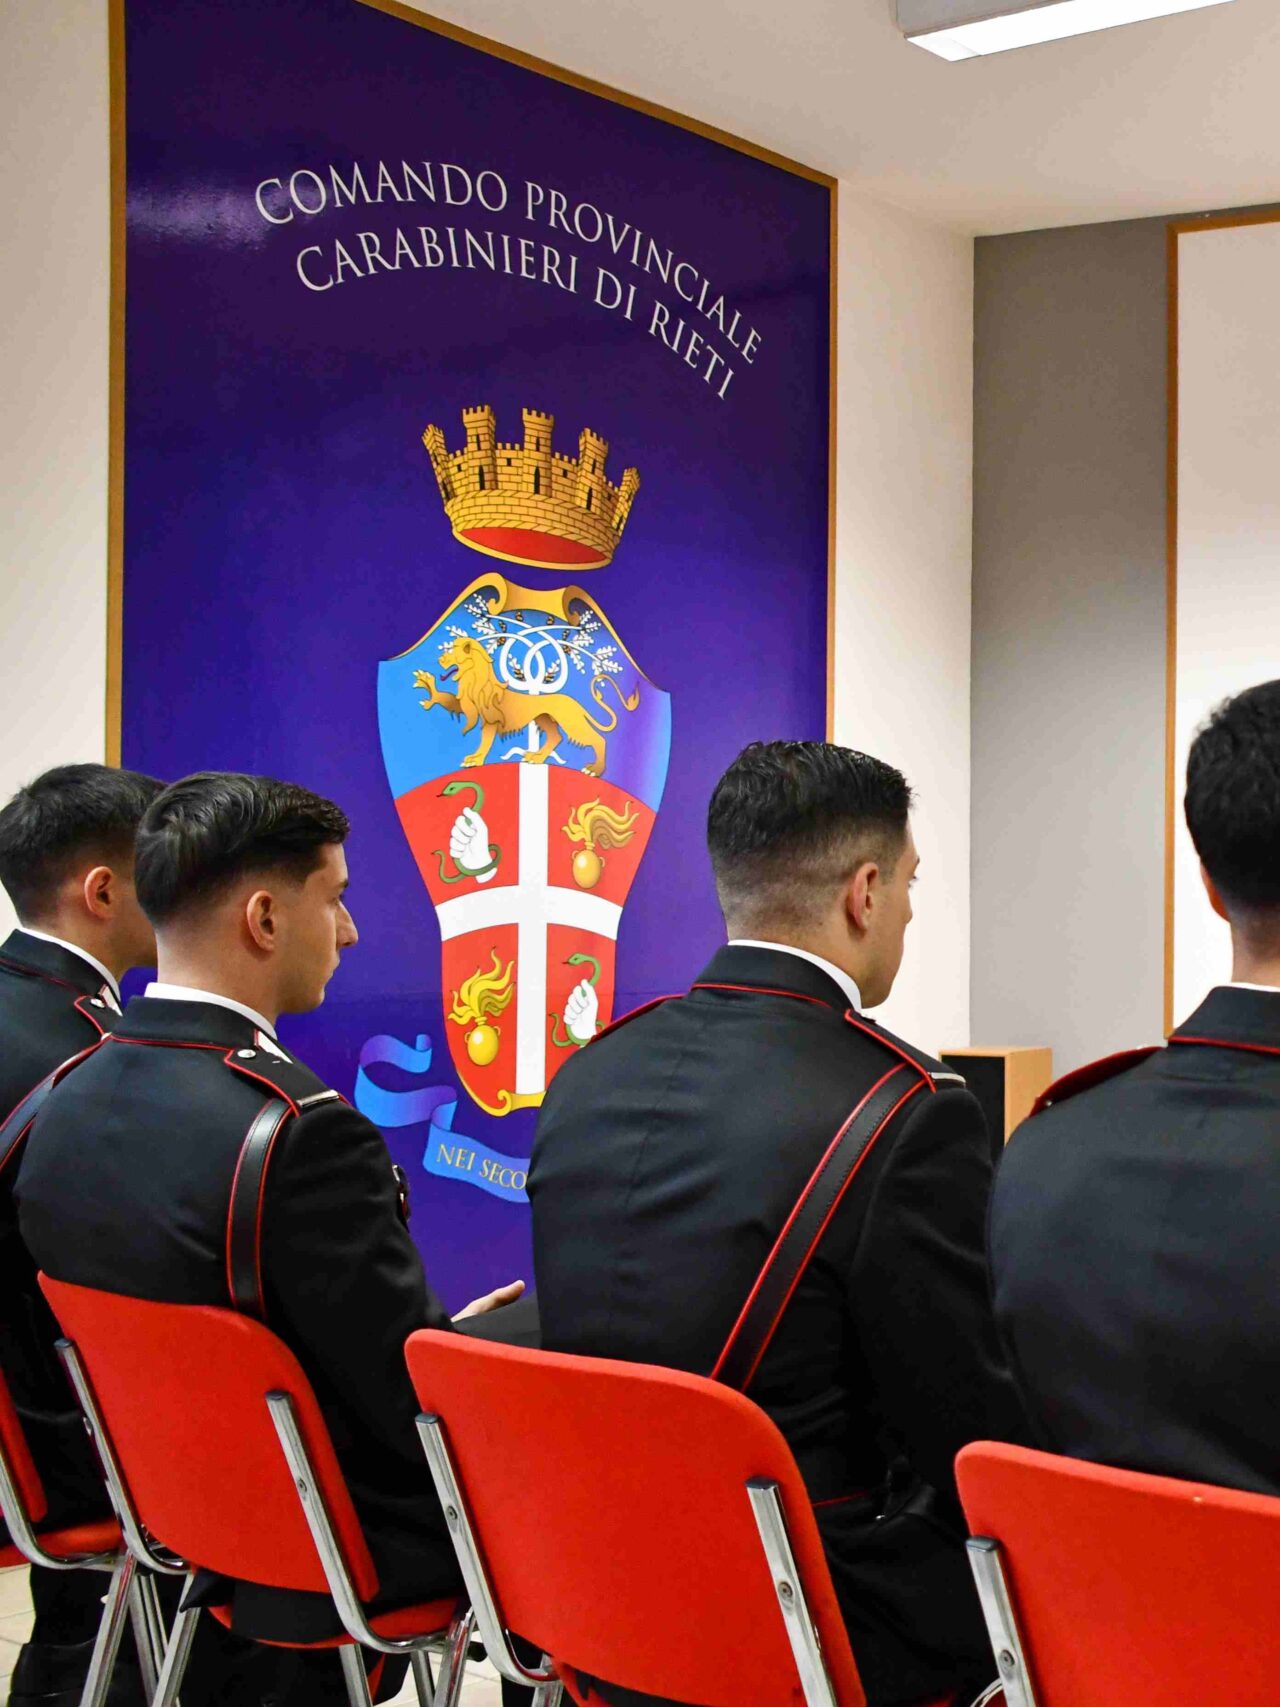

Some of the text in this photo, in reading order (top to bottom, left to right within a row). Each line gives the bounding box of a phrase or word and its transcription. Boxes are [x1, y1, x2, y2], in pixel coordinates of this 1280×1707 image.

[255, 160, 762, 364] COMANDO PROVINCIALE
[296, 226, 735, 400] CARABINIERI DI RIETI
[436, 1143, 528, 1190] NEI SECO
